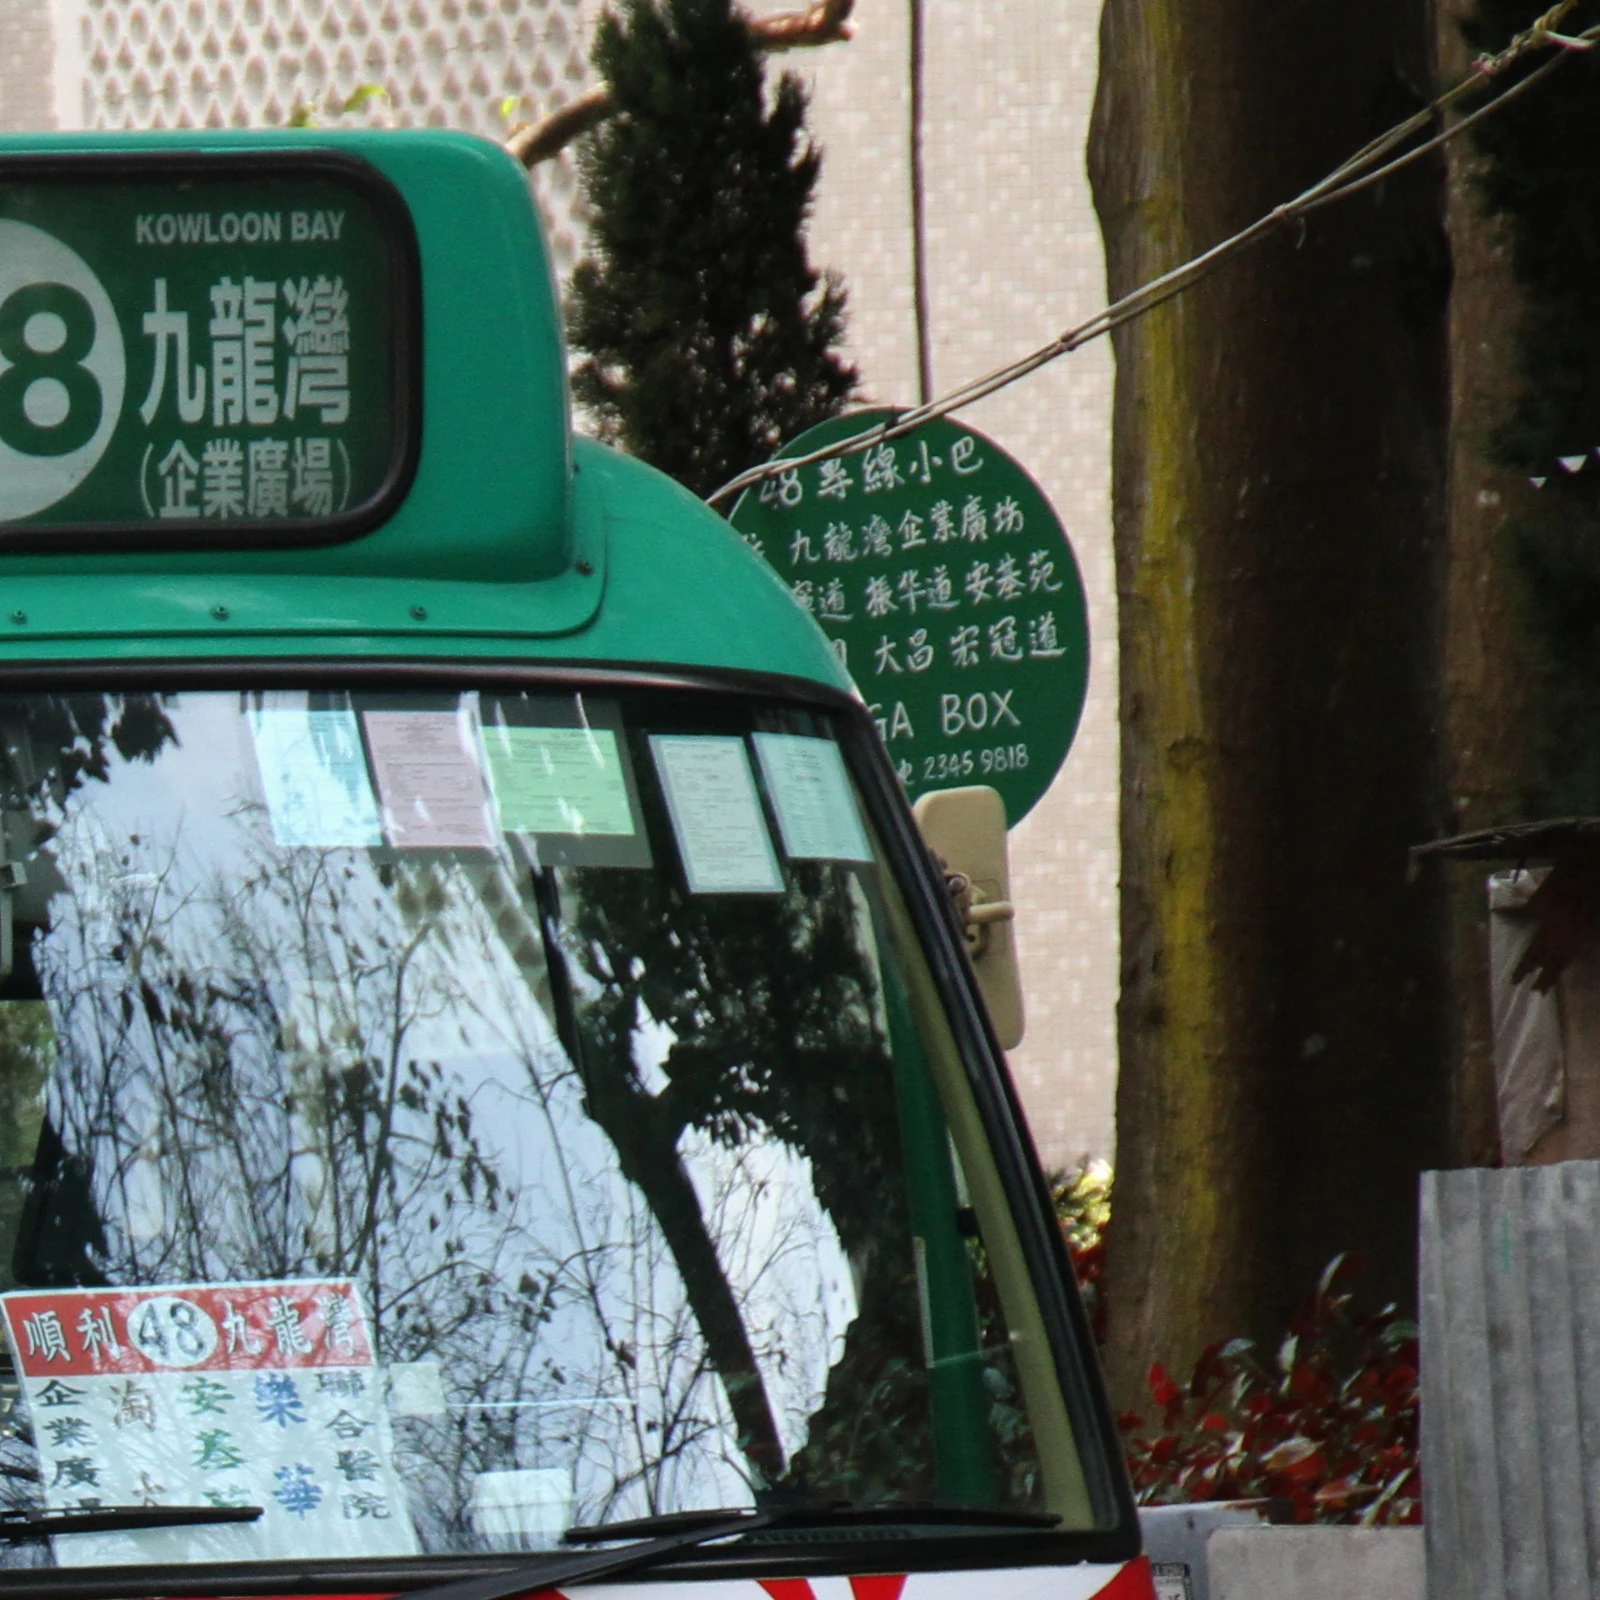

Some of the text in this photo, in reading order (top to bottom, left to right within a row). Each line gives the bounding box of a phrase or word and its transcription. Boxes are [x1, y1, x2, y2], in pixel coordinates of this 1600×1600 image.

[135, 210, 347, 247] KOWLOON BAY
[139, 274, 353, 428] 九龍灣
[140, 437, 353, 521] (企業廣場)
[941, 689, 1021, 738] BOX
[923, 747, 974, 782] 2345
[980, 742, 1030, 774] 9818
[22, 1303, 124, 1366] 順利
[138, 1299, 205, 1361] 48
[221, 1294, 359, 1359] 九龍灣
[253, 1371, 324, 1520] 樂華
